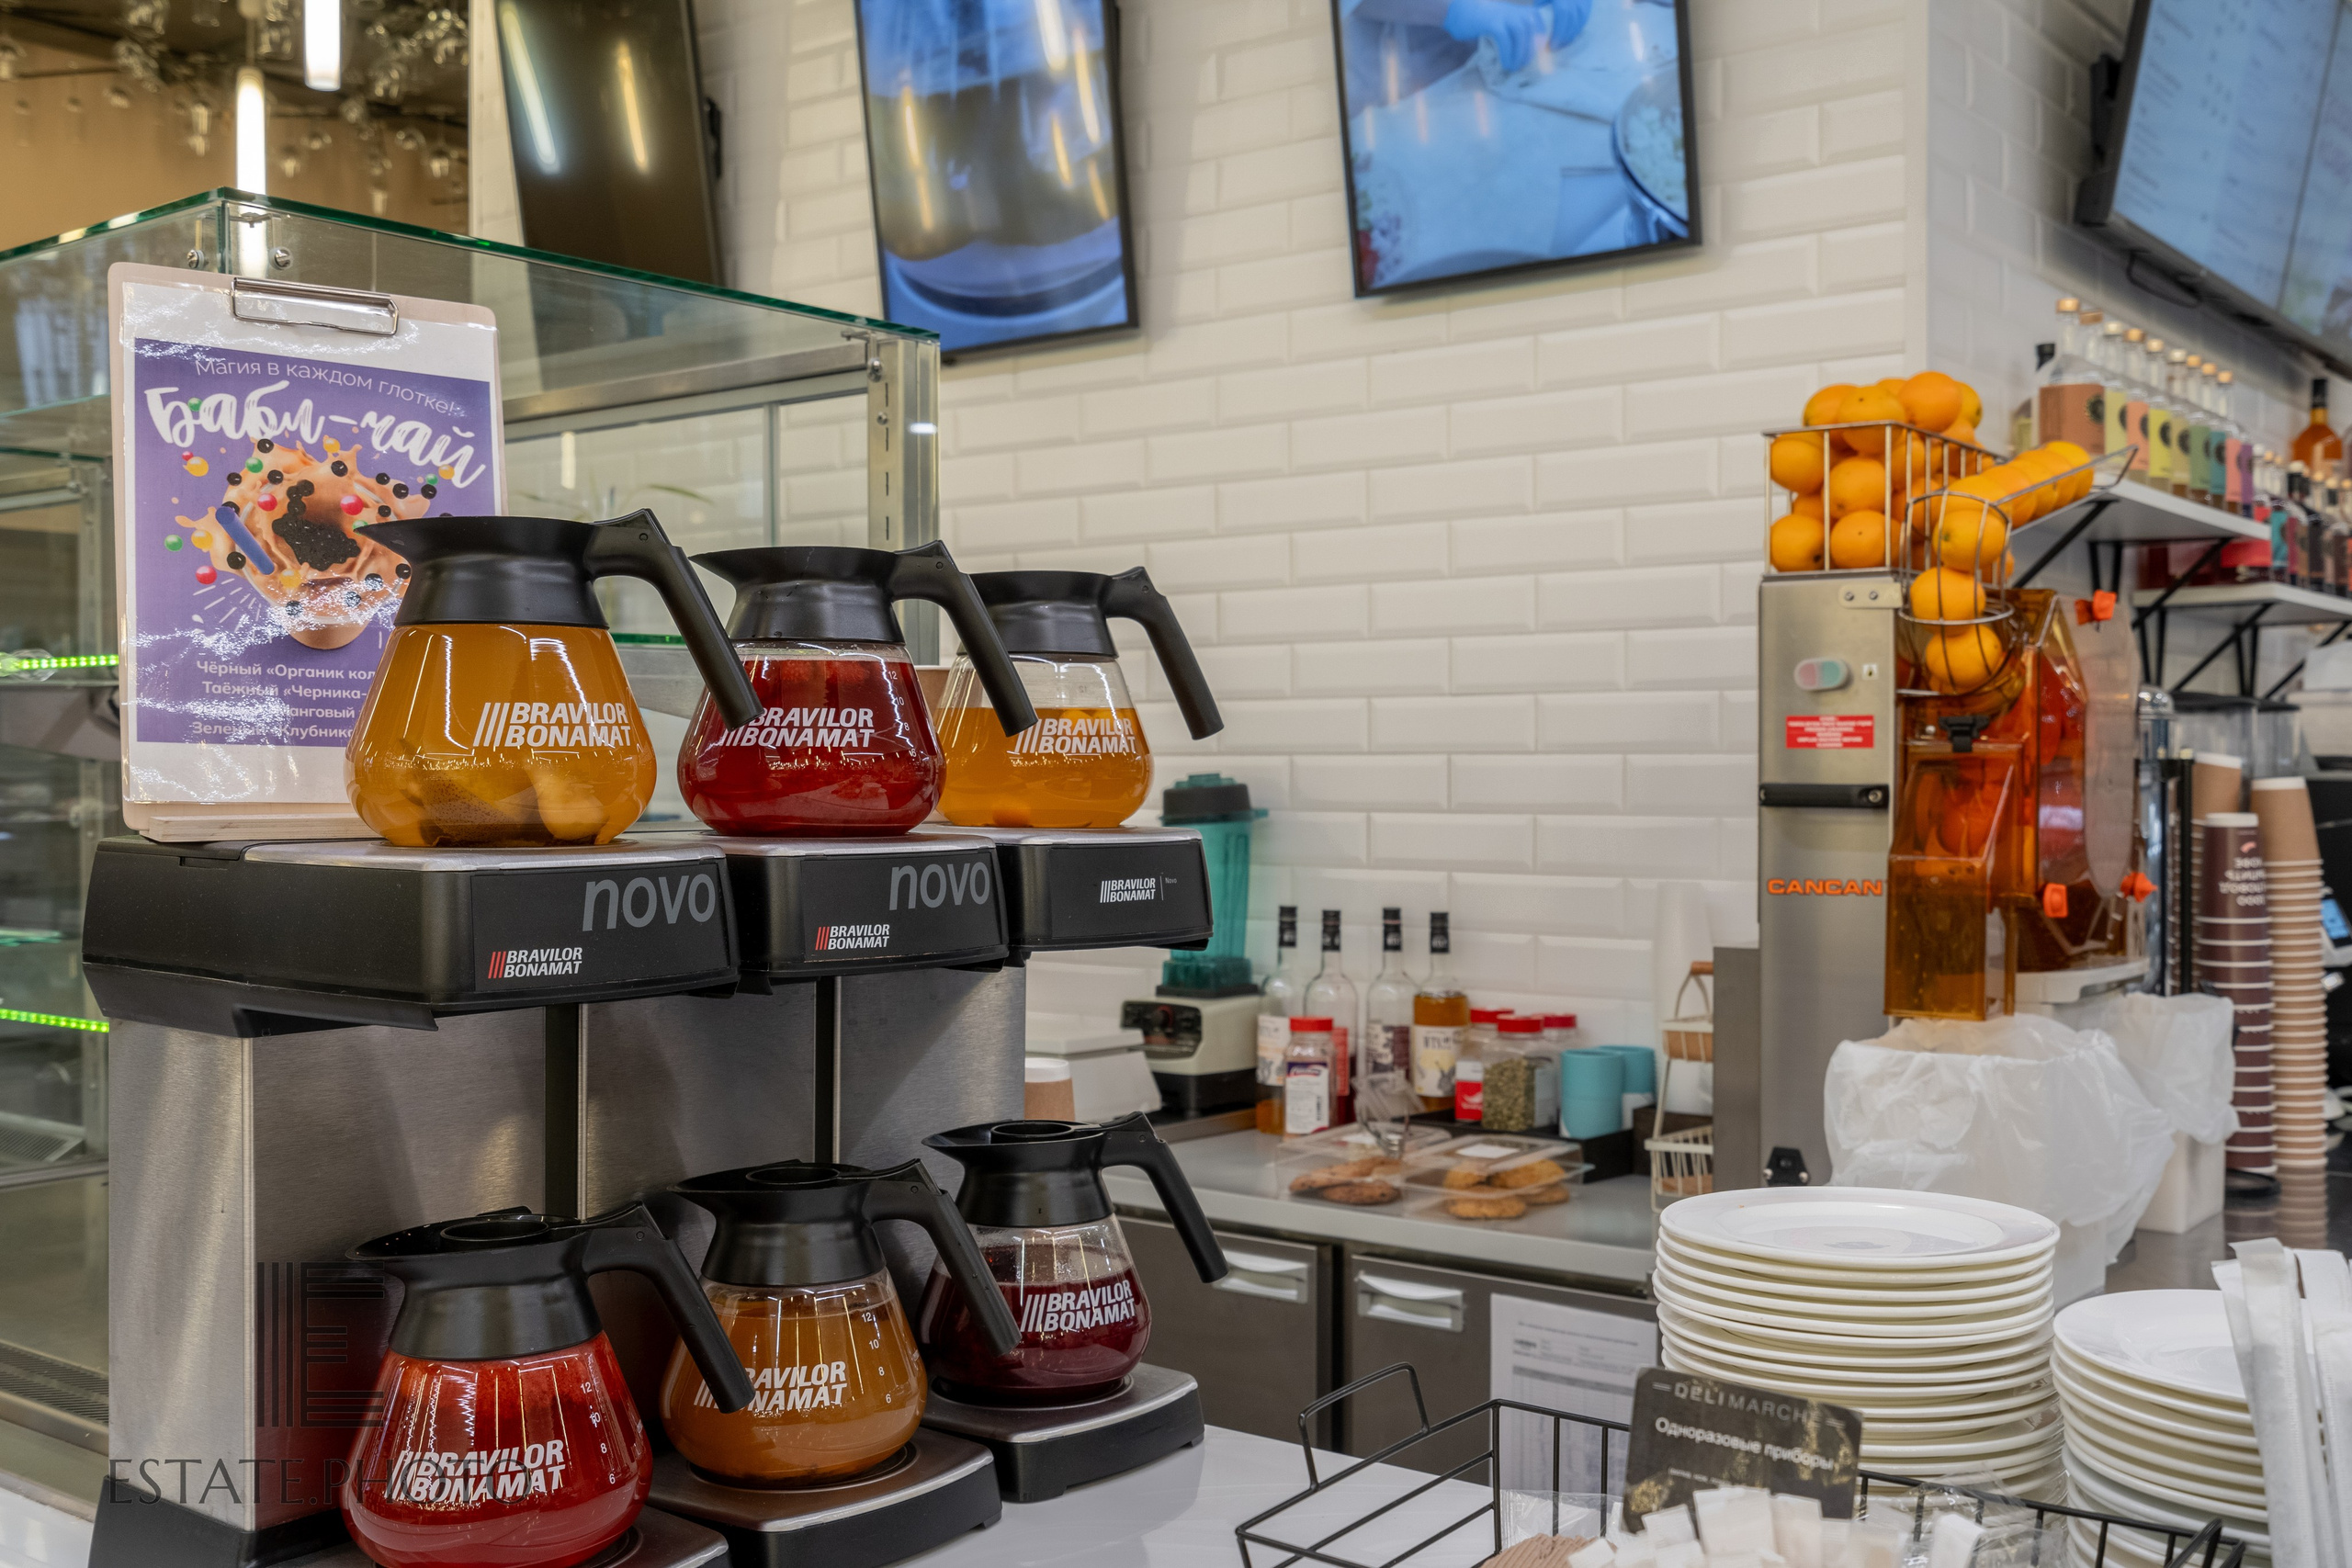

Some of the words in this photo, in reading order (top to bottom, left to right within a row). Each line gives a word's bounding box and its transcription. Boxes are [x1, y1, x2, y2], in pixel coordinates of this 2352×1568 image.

[195, 359, 261, 376] Магия
[267, 362, 280, 376] в
[287, 364, 373, 390] каждом
[379, 380, 458, 416] глотке!
[144, 379, 486, 489] Бабл-чай
[197, 660, 262, 677] Чёрный
[266, 663, 345, 680] «Органик
[888, 671, 899, 680] 12
[509, 702, 629, 725] BRAVILOR
[749, 706, 875, 728] BRAVILOR
[903, 722, 910, 731] 8
[1042, 717, 1134, 736] BRAVILOR
[504, 725, 631, 748] BONAMAT
[740, 727, 876, 748] BONAMAT
[1038, 736, 1136, 754] BONAMAT
[888, 862, 990, 911] novo
[1110, 877, 1156, 891] BRAVILOR
[1767, 878, 1883, 896] CANCAN
[582, 874, 716, 932] novo
[1109, 889, 1157, 903] BONAMAT
[829, 924, 890, 938] BRAVILOR
[828, 936, 890, 950] BONAMAT
[506, 947, 583, 964] BRAVILOR
[503, 961, 582, 978] BONAMAT
[1046, 1279, 1134, 1313] BRAVILOR
[861, 1313, 873, 1324] 12
[1043, 1298, 1136, 1332] BONAMAT
[868, 1338, 880, 1350] 10
[877, 1366, 885, 1376] 8
[581, 1382, 593, 1394] 12
[742, 1382, 848, 1412] NAMAT
[1674, 1382, 1724, 1405] DELI
[885, 1393, 892, 1404] 6
[600, 1442, 607, 1454] 8
[1655, 1416, 1762, 1454] Одноразовые
[1764, 1443, 1835, 1471] приборы
[416, 1439, 566, 1477] BRAVILOR
[411, 1464, 566, 1502] BONAMAT
[608, 1472, 616, 1484] 6
